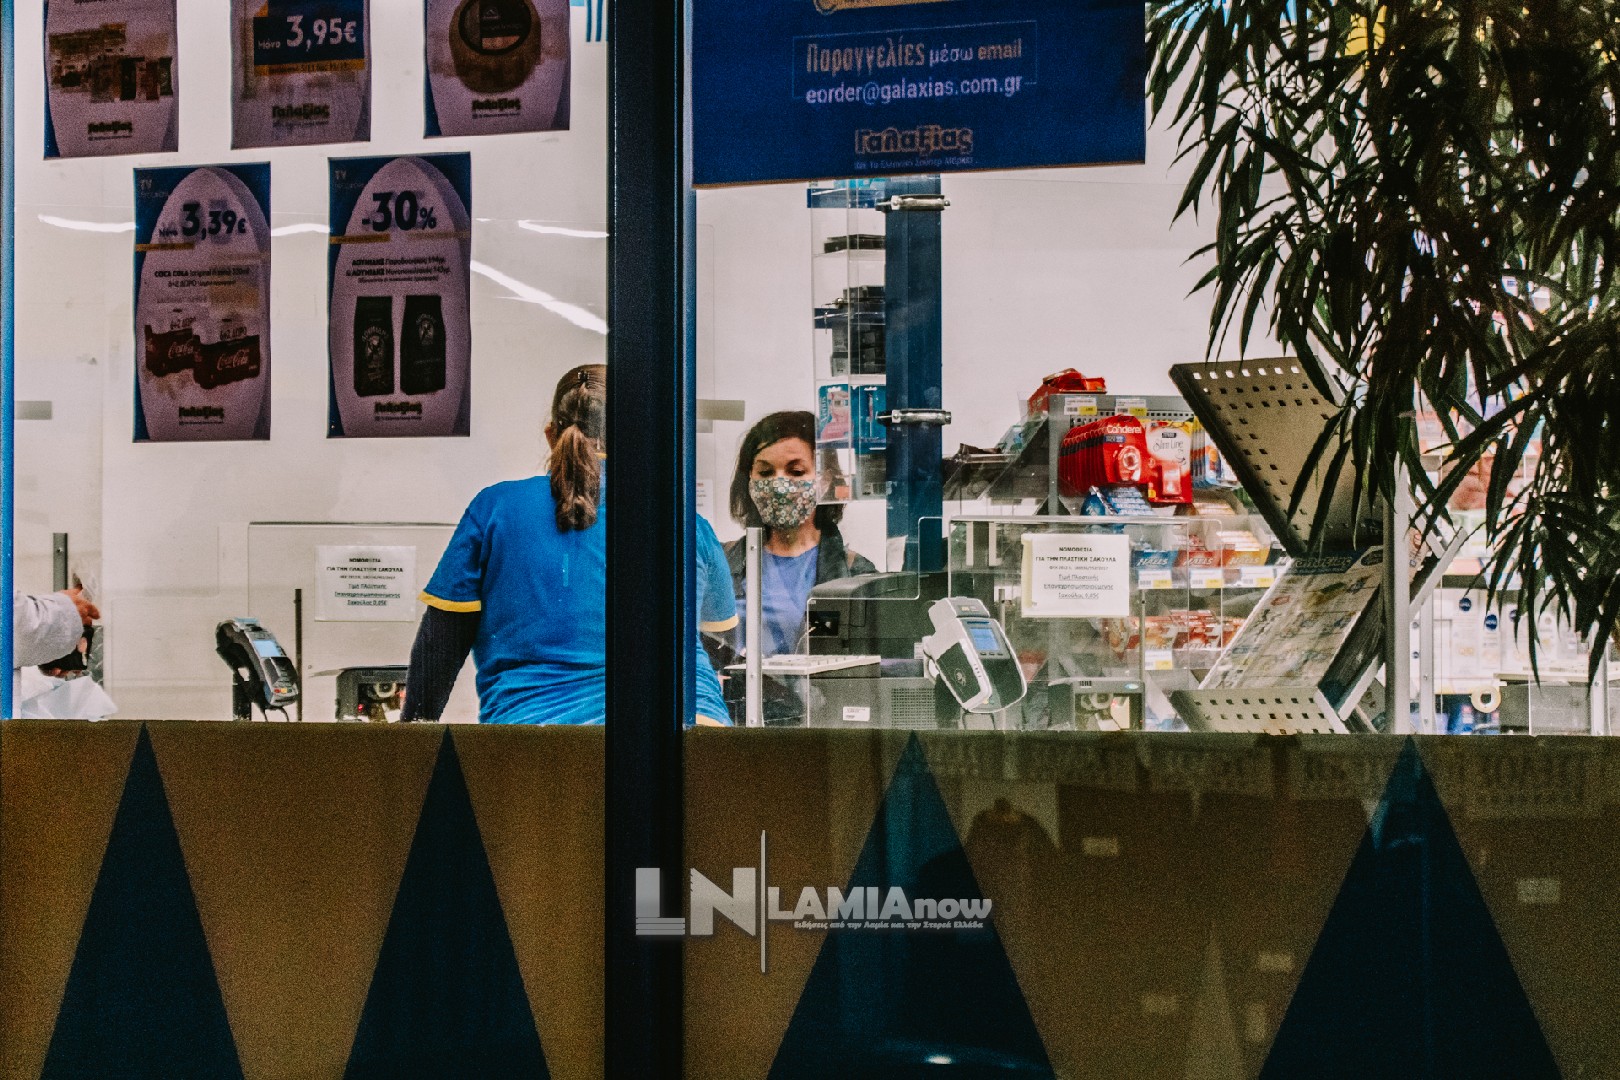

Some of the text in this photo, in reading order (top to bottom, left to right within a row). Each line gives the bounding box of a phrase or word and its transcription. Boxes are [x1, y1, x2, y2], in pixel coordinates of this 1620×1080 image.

[286, 15, 357, 52] 3,95€
[806, 35, 1022, 77] Παραγγελίες μέσω email
[805, 75, 1023, 105] eorder@galaxias.com.gr
[181, 201, 247, 241] 3,39€
[362, 190, 437, 232] -30%
[154, 270, 172, 278] COCA
[173, 269, 189, 277] COLA
[1106, 425, 1142, 434] Canderel
[1137, 557, 1169, 566] HALLS
[1229, 557, 1260, 565] HALLS
